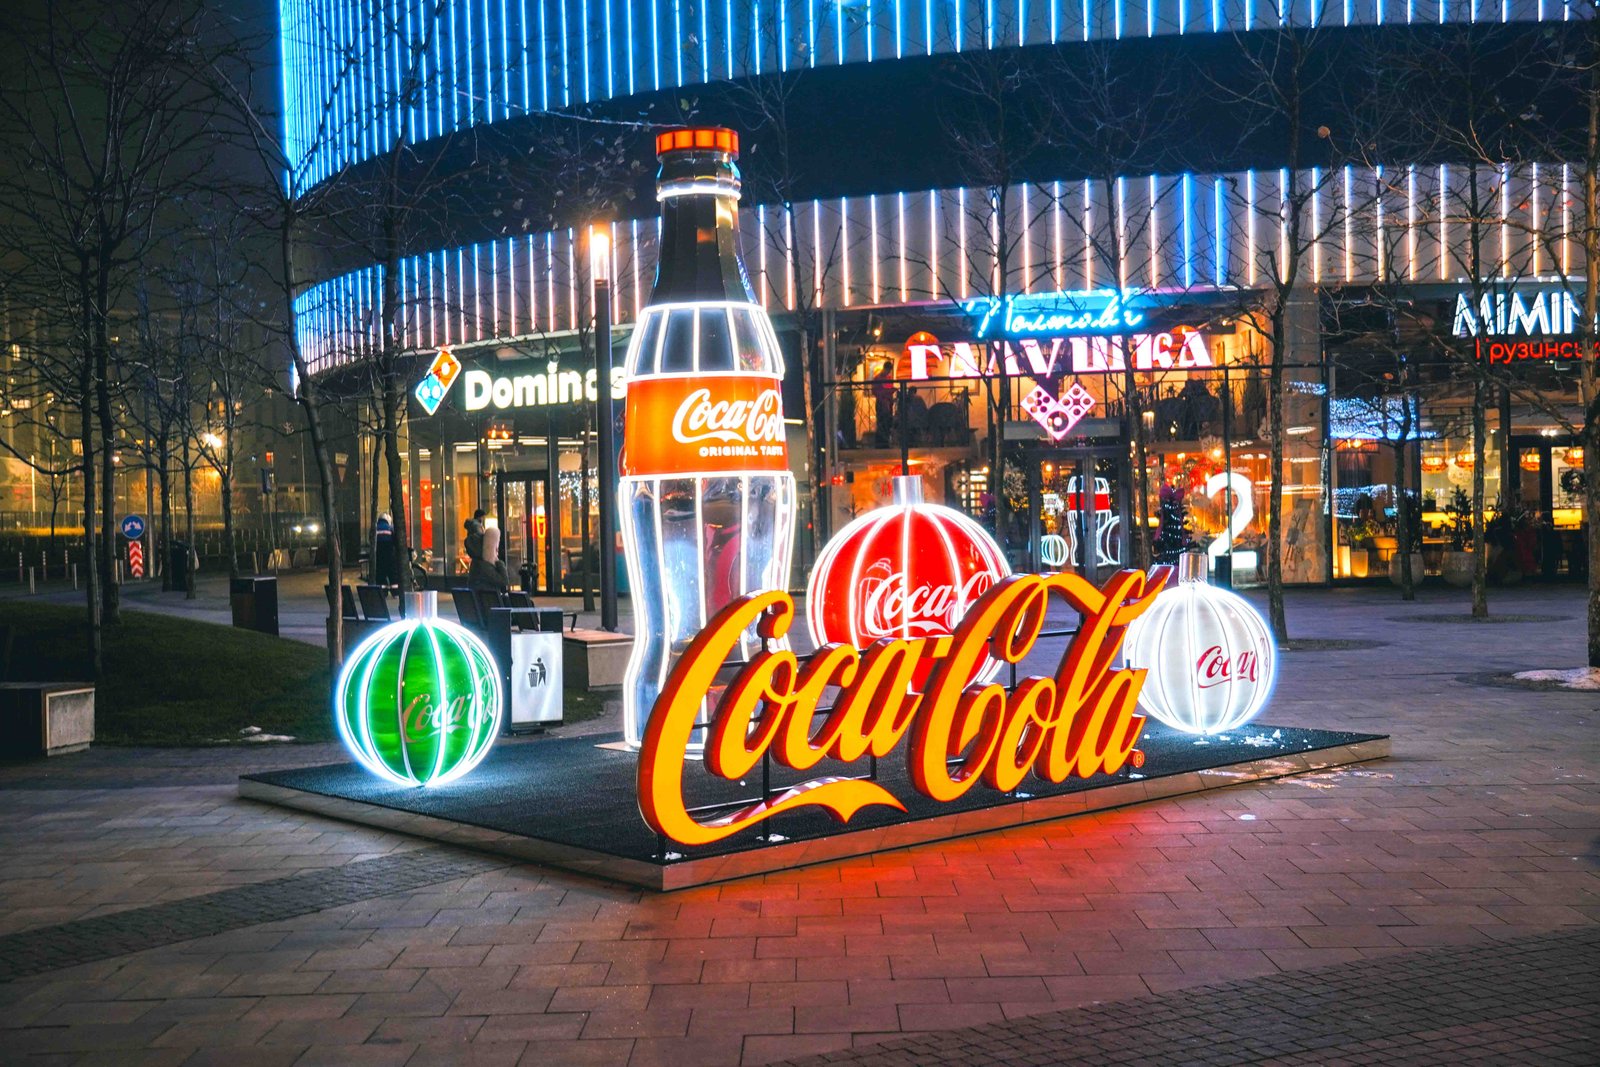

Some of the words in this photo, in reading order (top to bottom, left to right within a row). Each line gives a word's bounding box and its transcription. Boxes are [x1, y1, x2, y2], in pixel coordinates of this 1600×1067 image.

[1475, 337, 1600, 365] Грузинсь
[699, 446, 758, 457] ORIGINAL
[638, 570, 1174, 846] Coca-Cola
